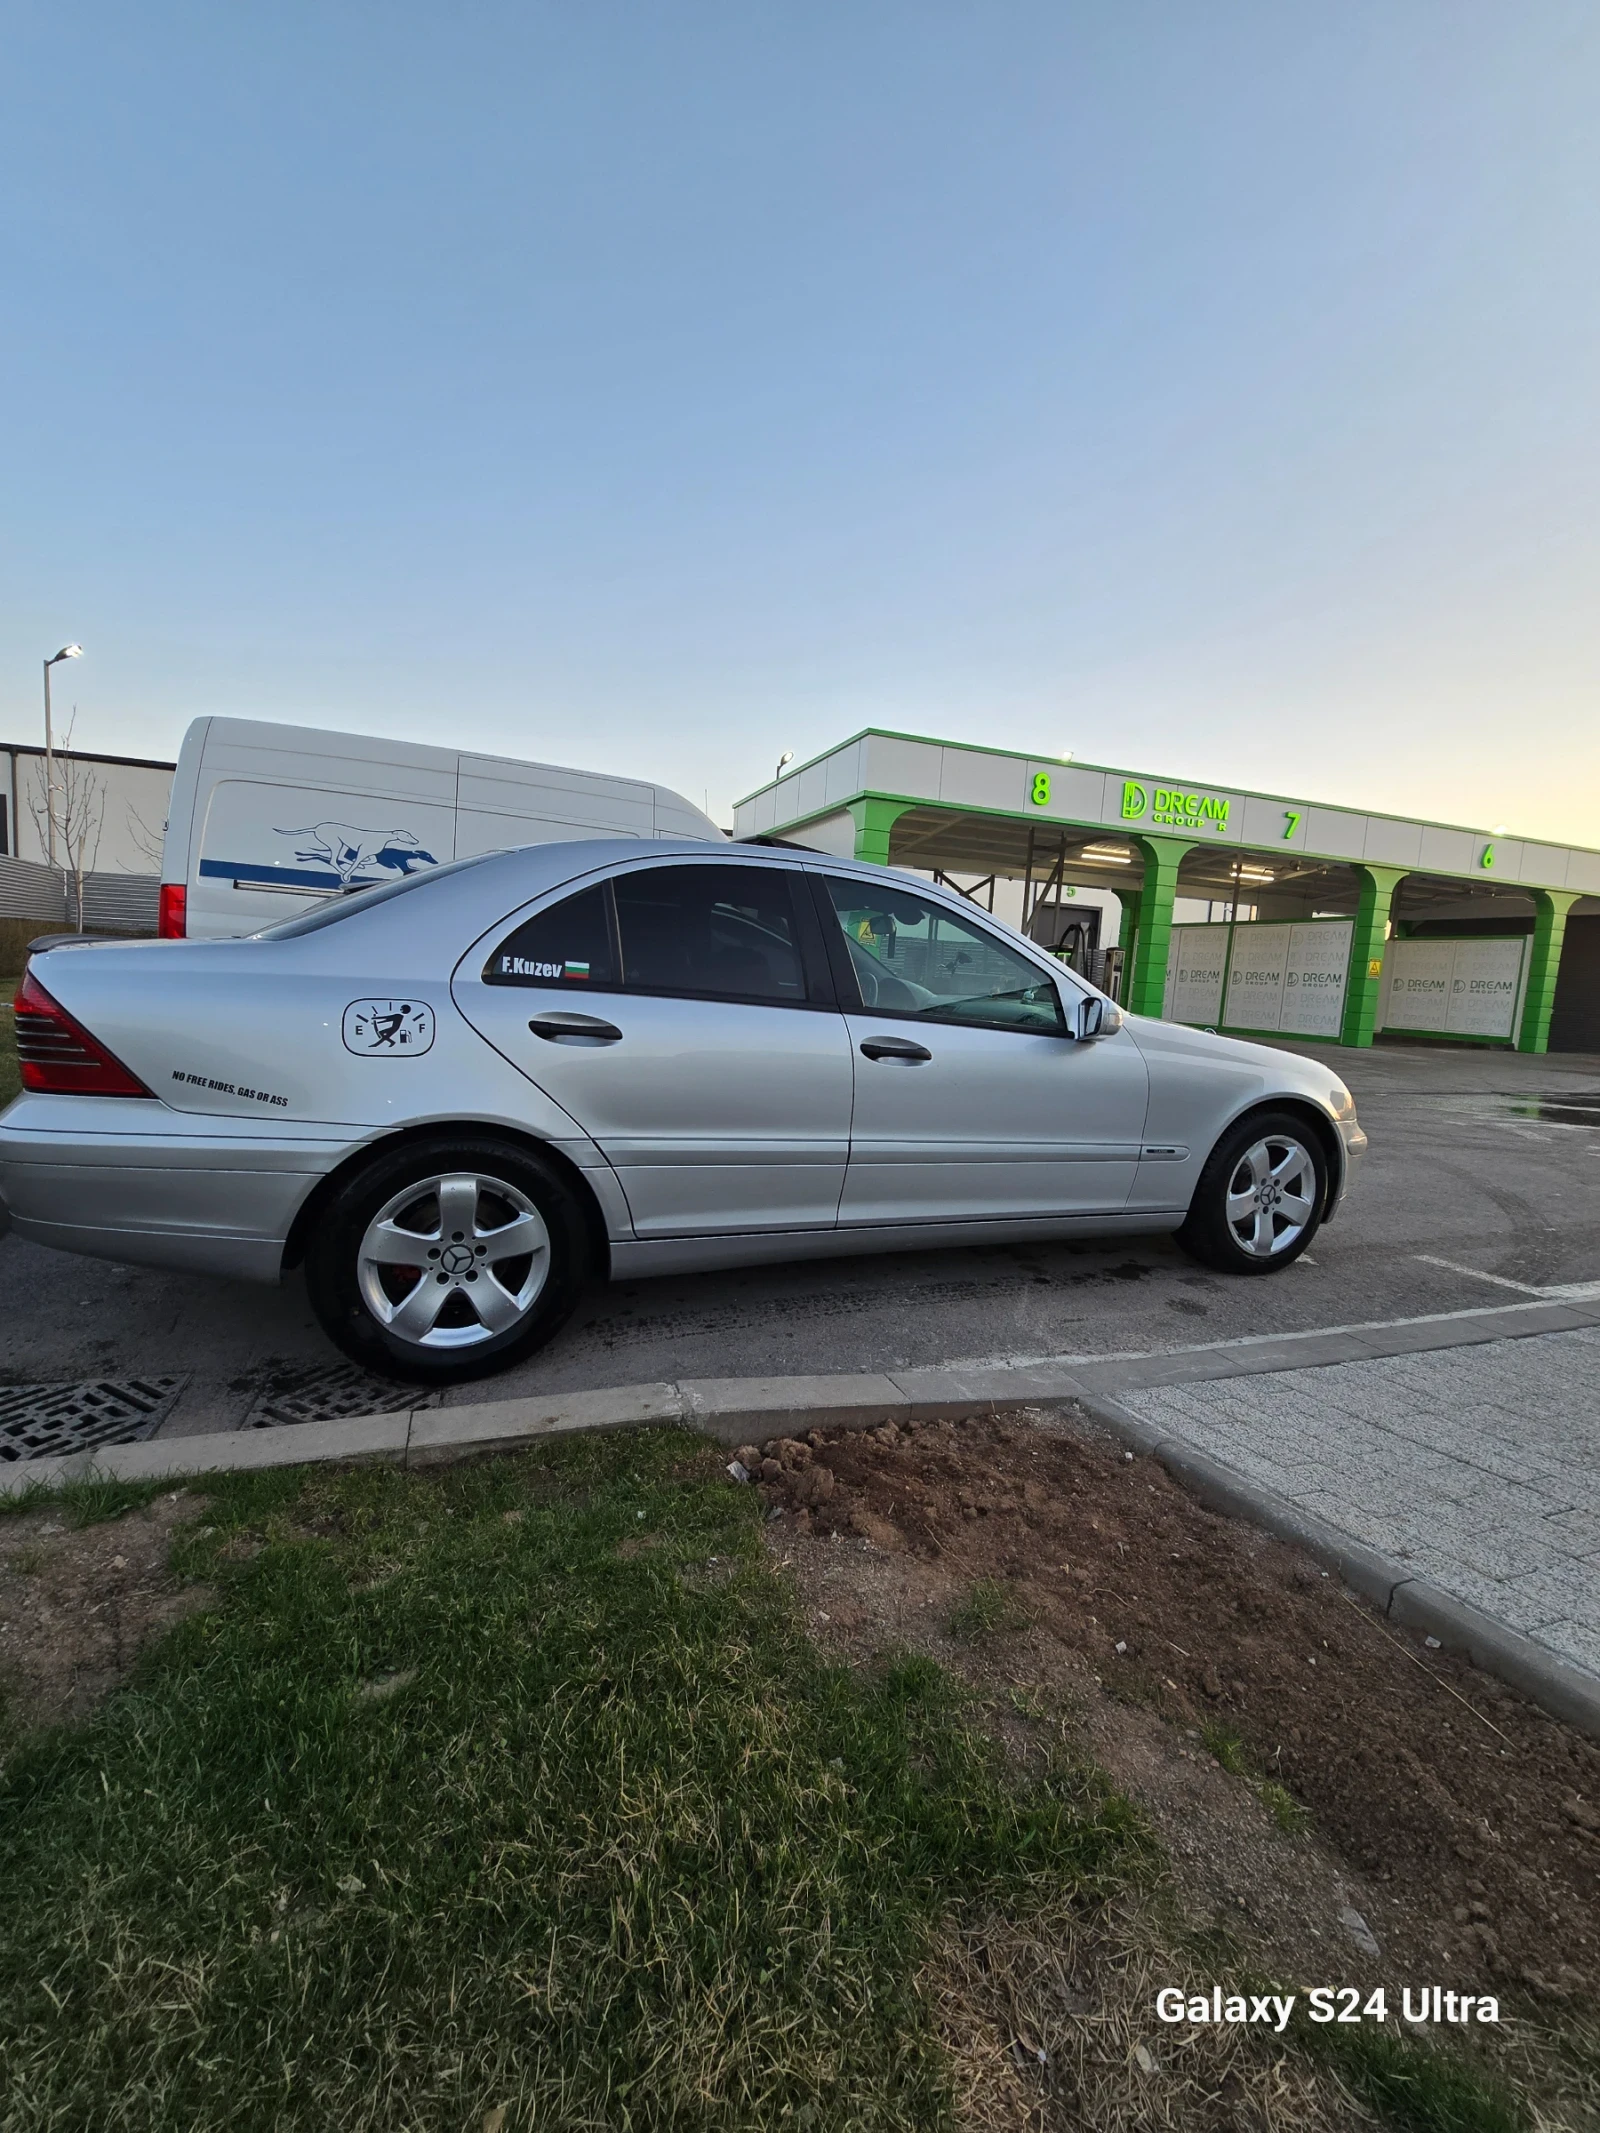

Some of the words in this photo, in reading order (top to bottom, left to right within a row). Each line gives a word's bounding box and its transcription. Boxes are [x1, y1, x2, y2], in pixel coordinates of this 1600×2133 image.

[1031, 772, 1050, 805] 8
[1154, 788, 1230, 820] DREAM
[1153, 813, 1205, 828] GROUP
[1283, 811, 1301, 839] 7
[1480, 843, 1495, 868] 6
[502, 956, 562, 978] F.Kuzev
[1190, 969, 1220, 980] DREAM
[1246, 971, 1280, 981] DREAM
[1303, 973, 1342, 983] DREAM
[1408, 979, 1445, 989] DREAM
[1470, 980, 1512, 991] DREAM
[355, 1025, 363, 1035] E
[418, 1023, 426, 1033] F
[172, 1070, 185, 1081] NO
[186, 1074, 208, 1087] FREE
[208, 1079, 236, 1095] RIDES,
[237, 1087, 256, 1099] GAS
[256, 1092, 270, 1102] OR
[269, 1095, 289, 1107] ASS
